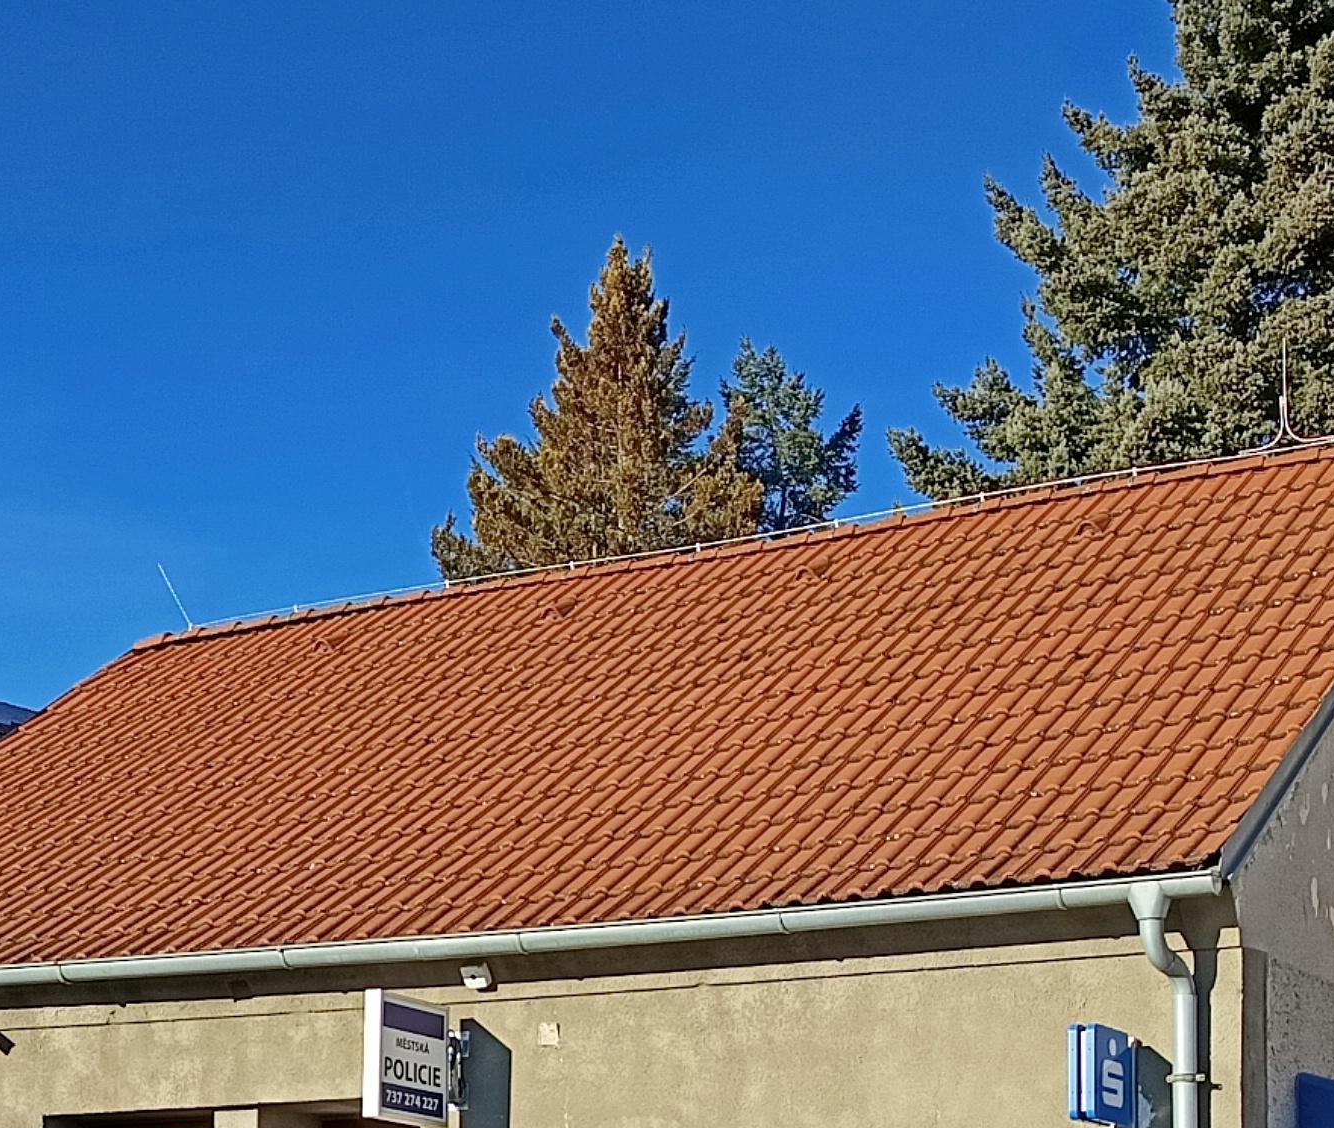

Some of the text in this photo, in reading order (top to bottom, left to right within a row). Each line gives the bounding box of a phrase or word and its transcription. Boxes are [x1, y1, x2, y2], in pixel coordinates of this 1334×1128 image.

[396, 1036, 430, 1055] MĚSTSKÁ
[384, 1056, 441, 1088] POLICIE
[386, 1089, 439, 1112] 737 274 227
